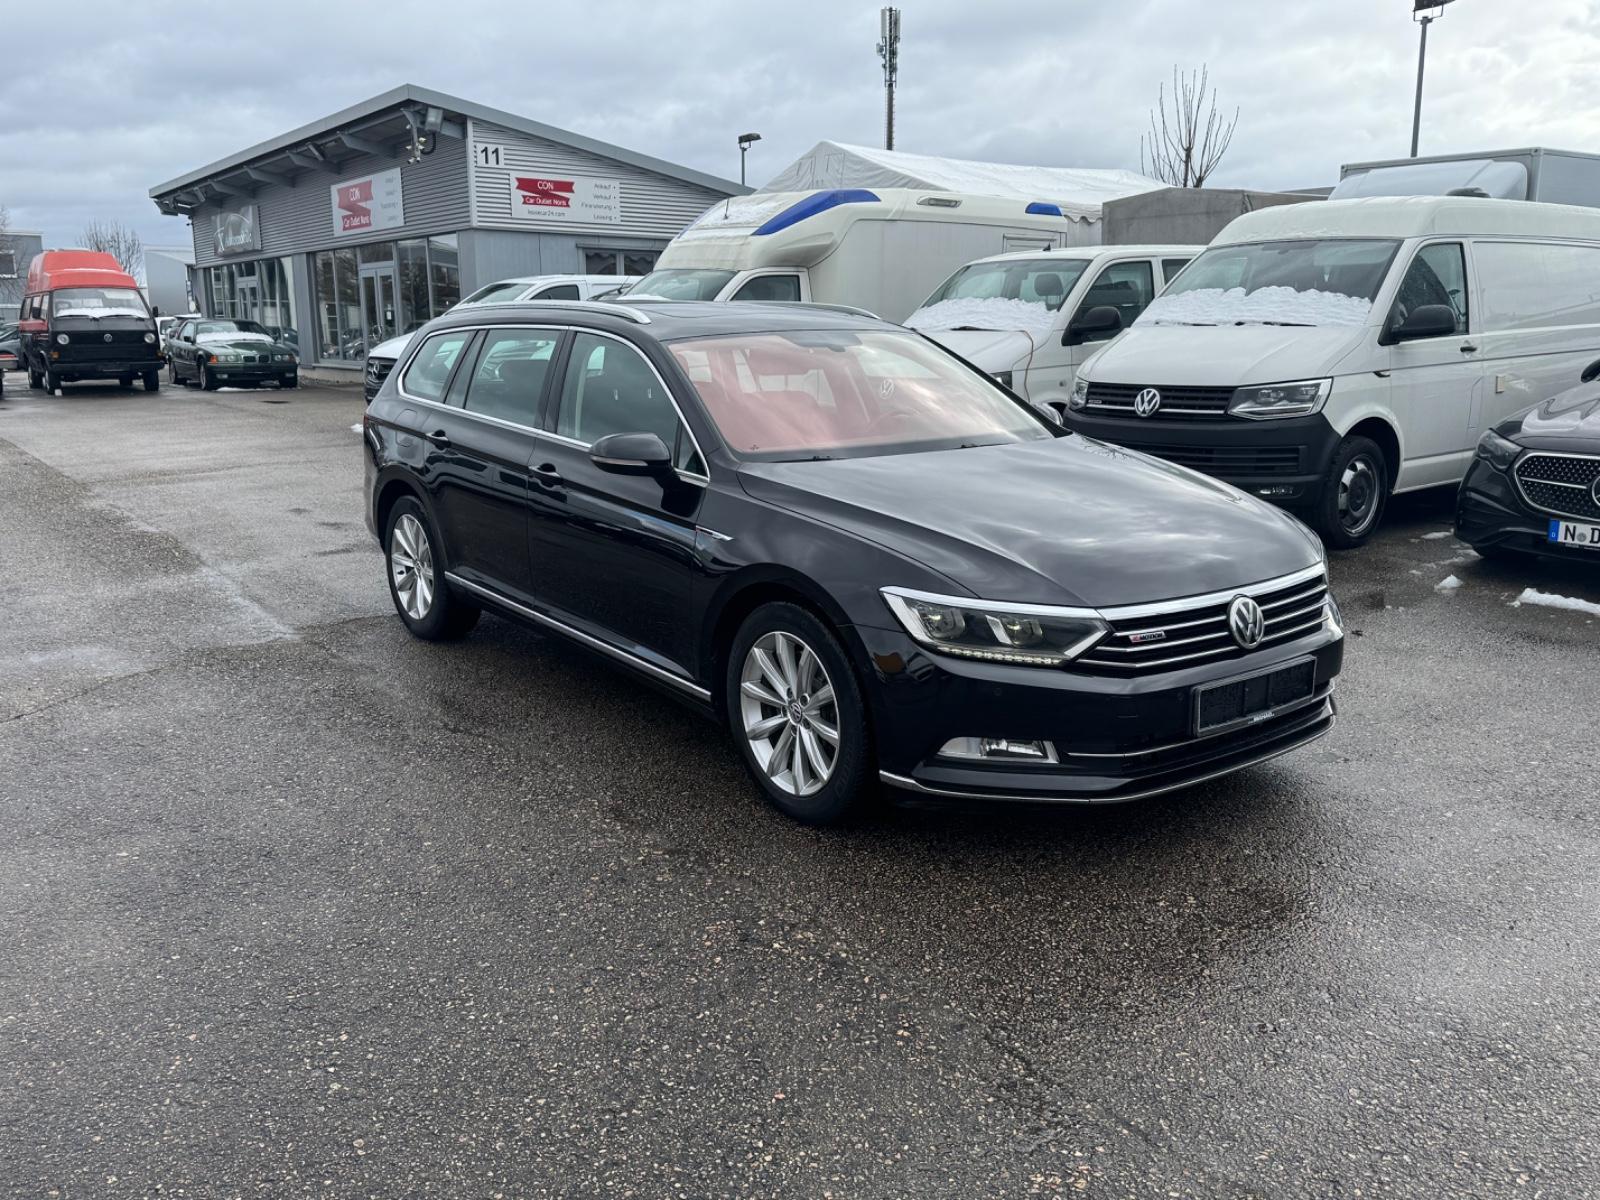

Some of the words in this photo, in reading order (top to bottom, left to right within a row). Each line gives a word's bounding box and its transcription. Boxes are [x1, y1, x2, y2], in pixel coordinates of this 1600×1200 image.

[481, 146, 499, 165] 11
[537, 181, 554, 190] CON
[1564, 524, 1577, 541] N
[1230, 597, 1264, 649] VW
